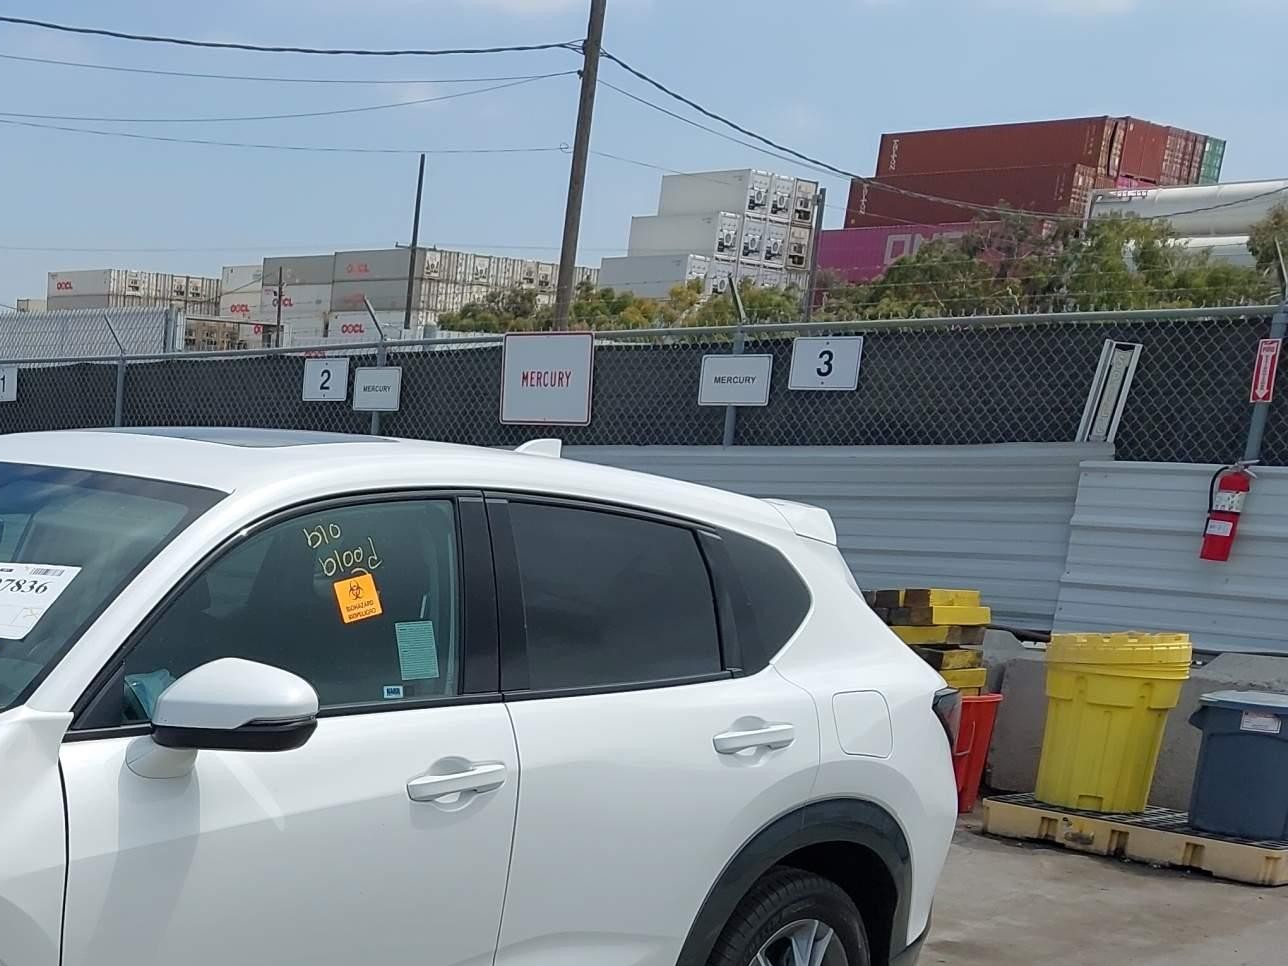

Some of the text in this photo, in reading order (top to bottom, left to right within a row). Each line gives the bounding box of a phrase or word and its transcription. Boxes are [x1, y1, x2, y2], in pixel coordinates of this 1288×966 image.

[56, 281, 73, 290] OOCL
[272, 297, 294, 307] OCL
[230, 304, 249, 313] OOCL
[341, 324, 364, 333] OOCL
[816, 350, 833, 377] 3
[0, 374, 5, 393] 1
[319, 369, 331, 390] 2
[521, 370, 572, 388] MERCURY
[713, 375, 757, 384] MERCURY
[362, 385, 392, 393] MERCURY
[345, 599, 374, 612] BIOHAZARD
